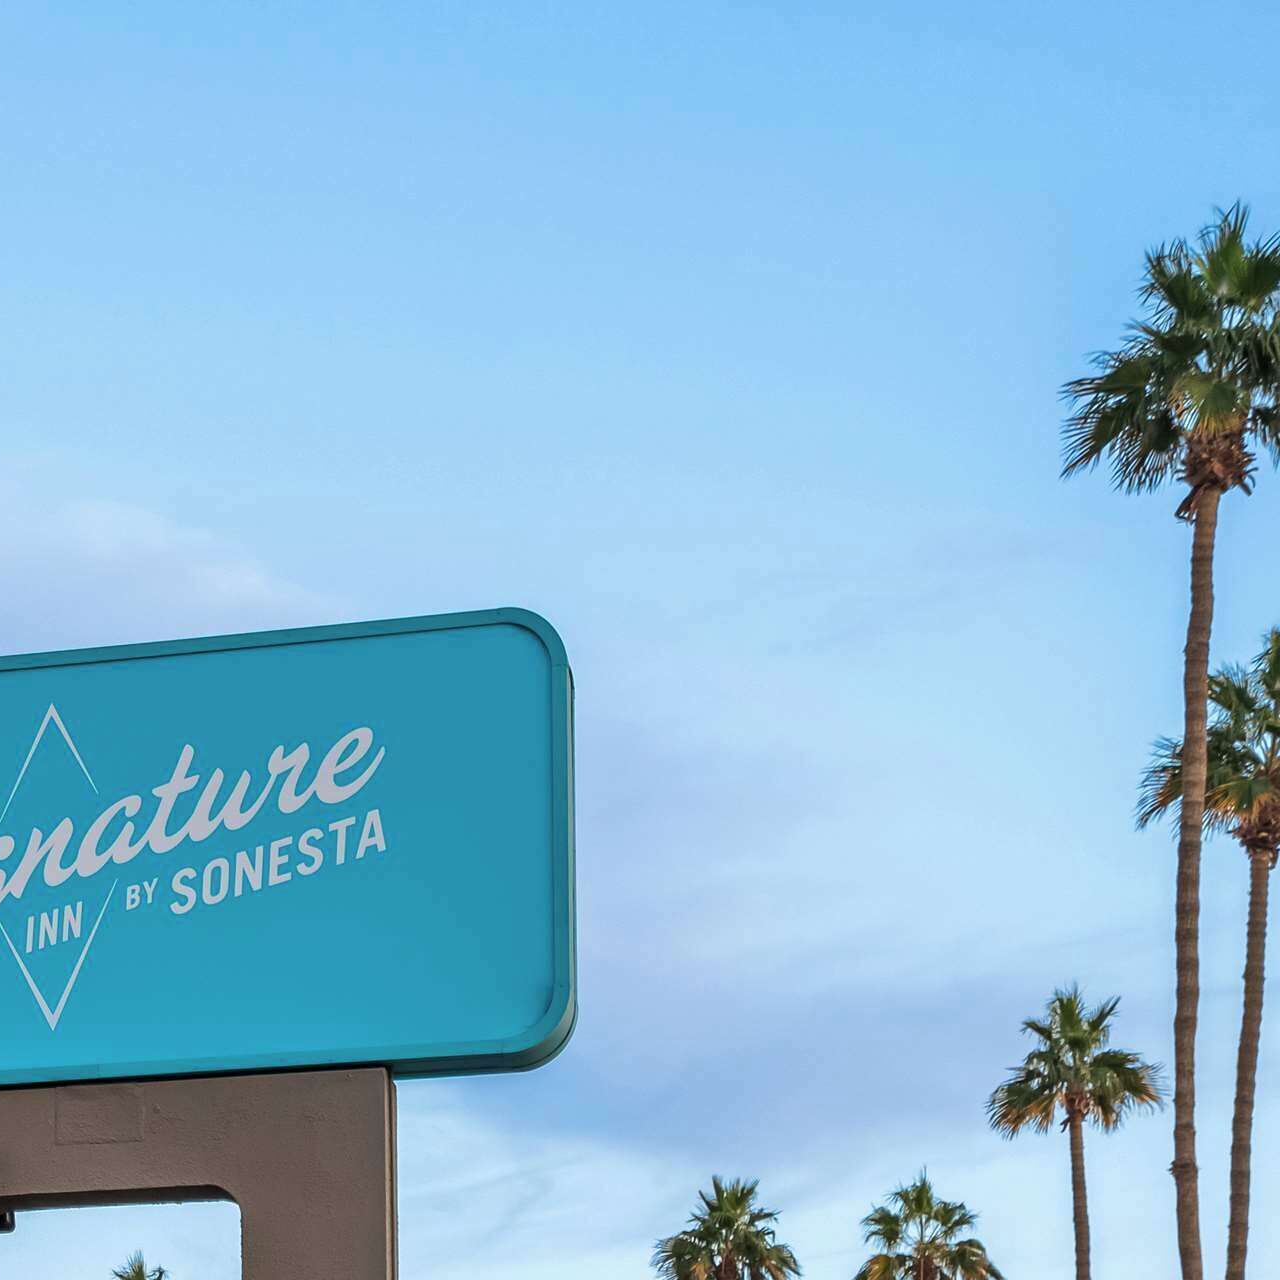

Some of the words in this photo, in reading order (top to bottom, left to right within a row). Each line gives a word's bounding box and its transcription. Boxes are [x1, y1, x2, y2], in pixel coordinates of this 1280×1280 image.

[25, 901, 84, 953] INN
[126, 878, 158, 910] BY
[169, 809, 386, 914] SONESTA
